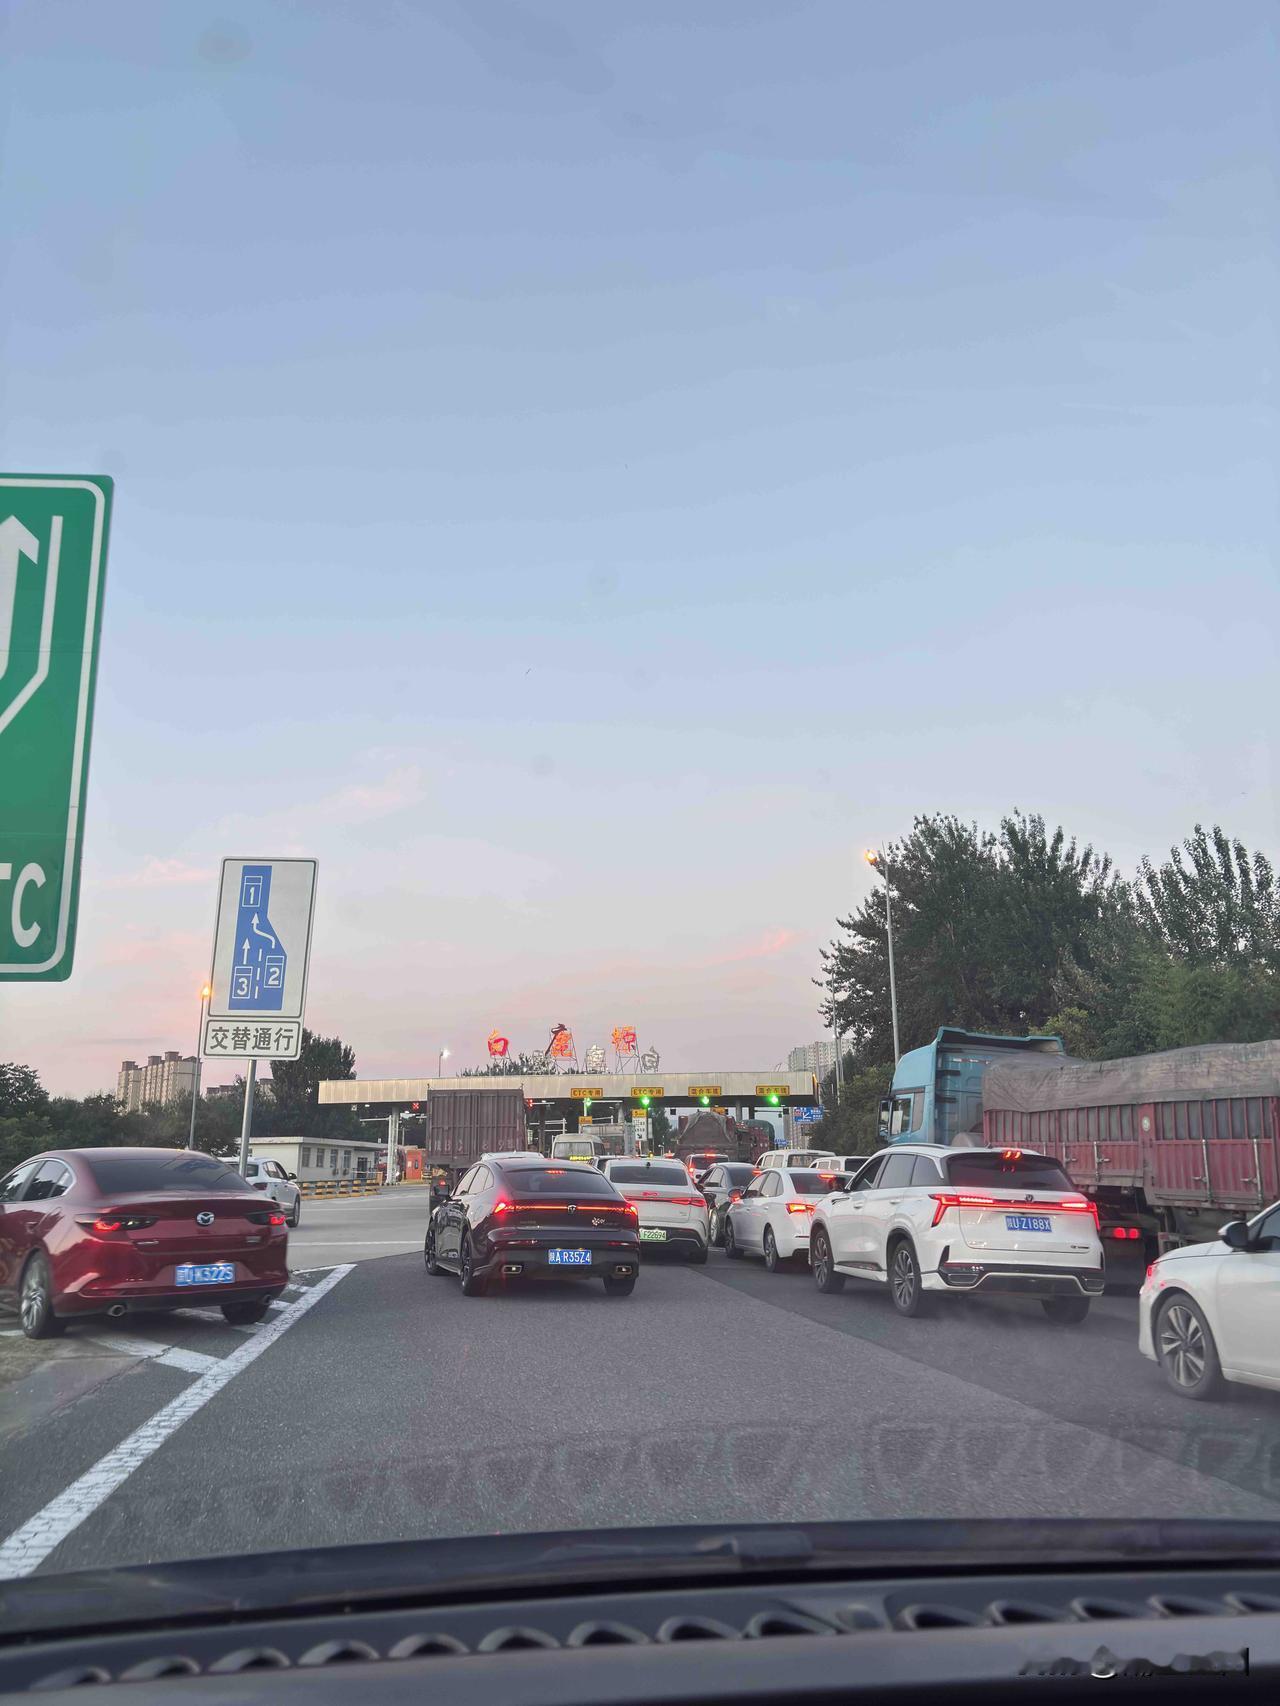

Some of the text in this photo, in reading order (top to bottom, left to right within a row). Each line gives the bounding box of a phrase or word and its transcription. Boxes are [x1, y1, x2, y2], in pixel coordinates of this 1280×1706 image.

[249, 886, 256, 904] 1
[268, 967, 280, 985] 2
[236, 977, 248, 996] 3
[210, 1026, 294, 1052] 交替通行
